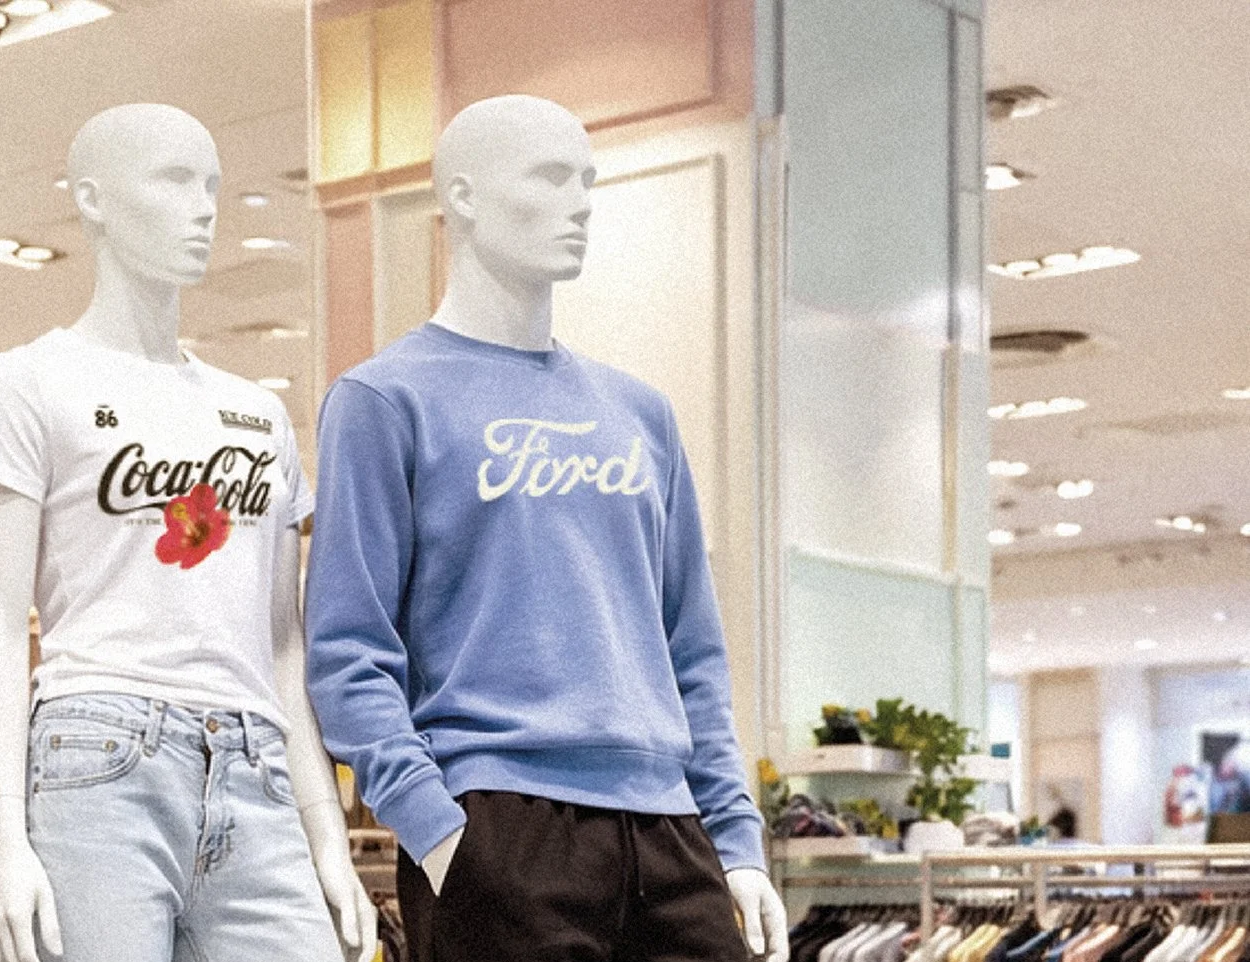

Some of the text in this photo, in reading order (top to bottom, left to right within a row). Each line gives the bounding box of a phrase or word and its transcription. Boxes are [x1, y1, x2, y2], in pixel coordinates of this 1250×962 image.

[95, 409, 119, 428] 86
[97, 442, 277, 517] Coca-Cola
[477, 418, 652, 502] Ford
